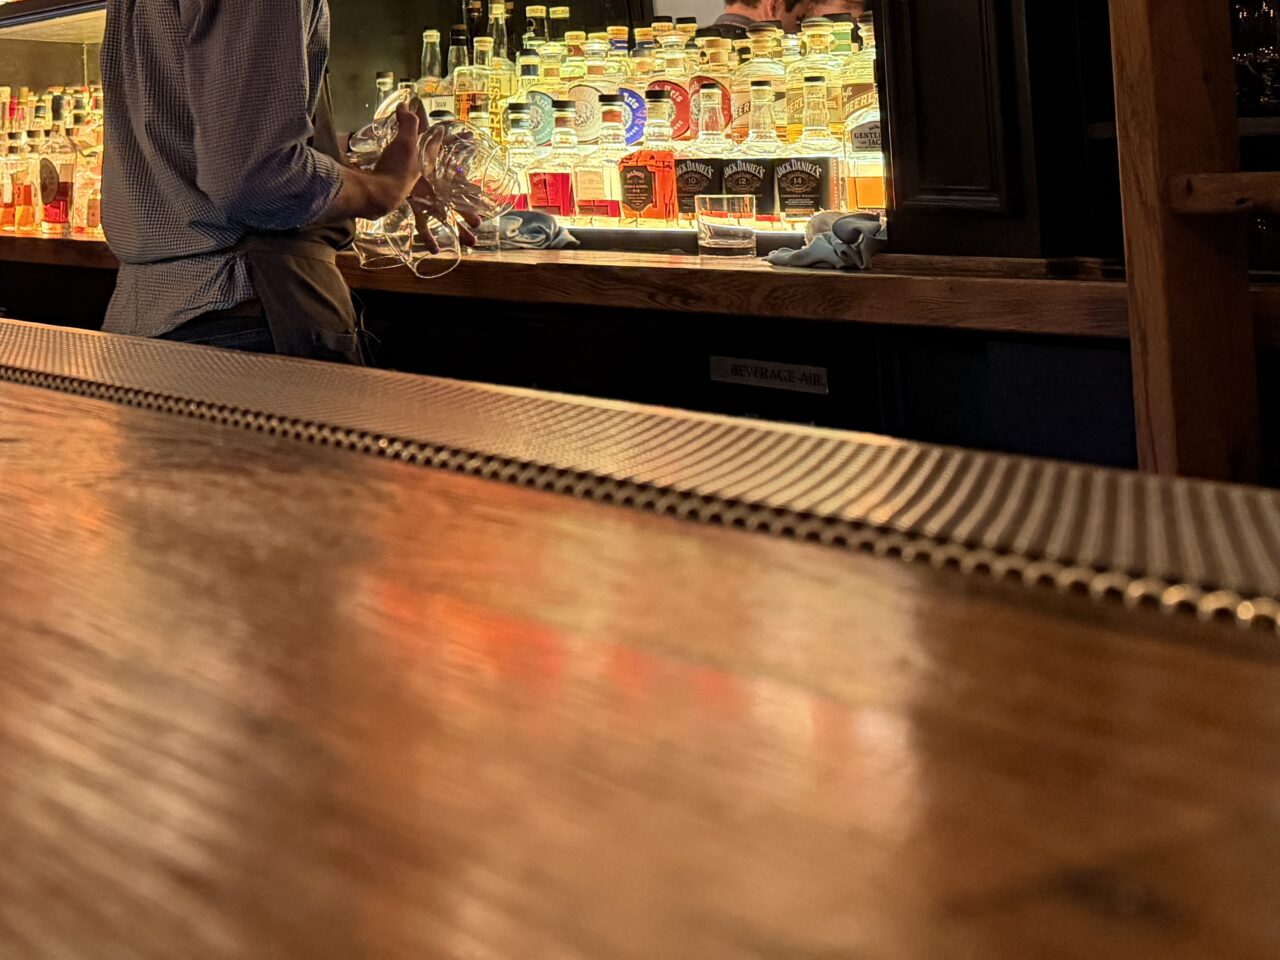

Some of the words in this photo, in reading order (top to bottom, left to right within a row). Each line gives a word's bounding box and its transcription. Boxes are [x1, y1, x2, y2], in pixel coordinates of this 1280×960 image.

[622, 91, 640, 109] Arts
[844, 90, 879, 114] PEERL
[853, 131, 881, 140] GENTL
[686, 160, 715, 180] DANIEL'S
[723, 163, 738, 178] JACK
[736, 159, 766, 179] DANIEL'S
[776, 163, 793, 179] JACK
[791, 159, 822, 179] DANIEL'S
